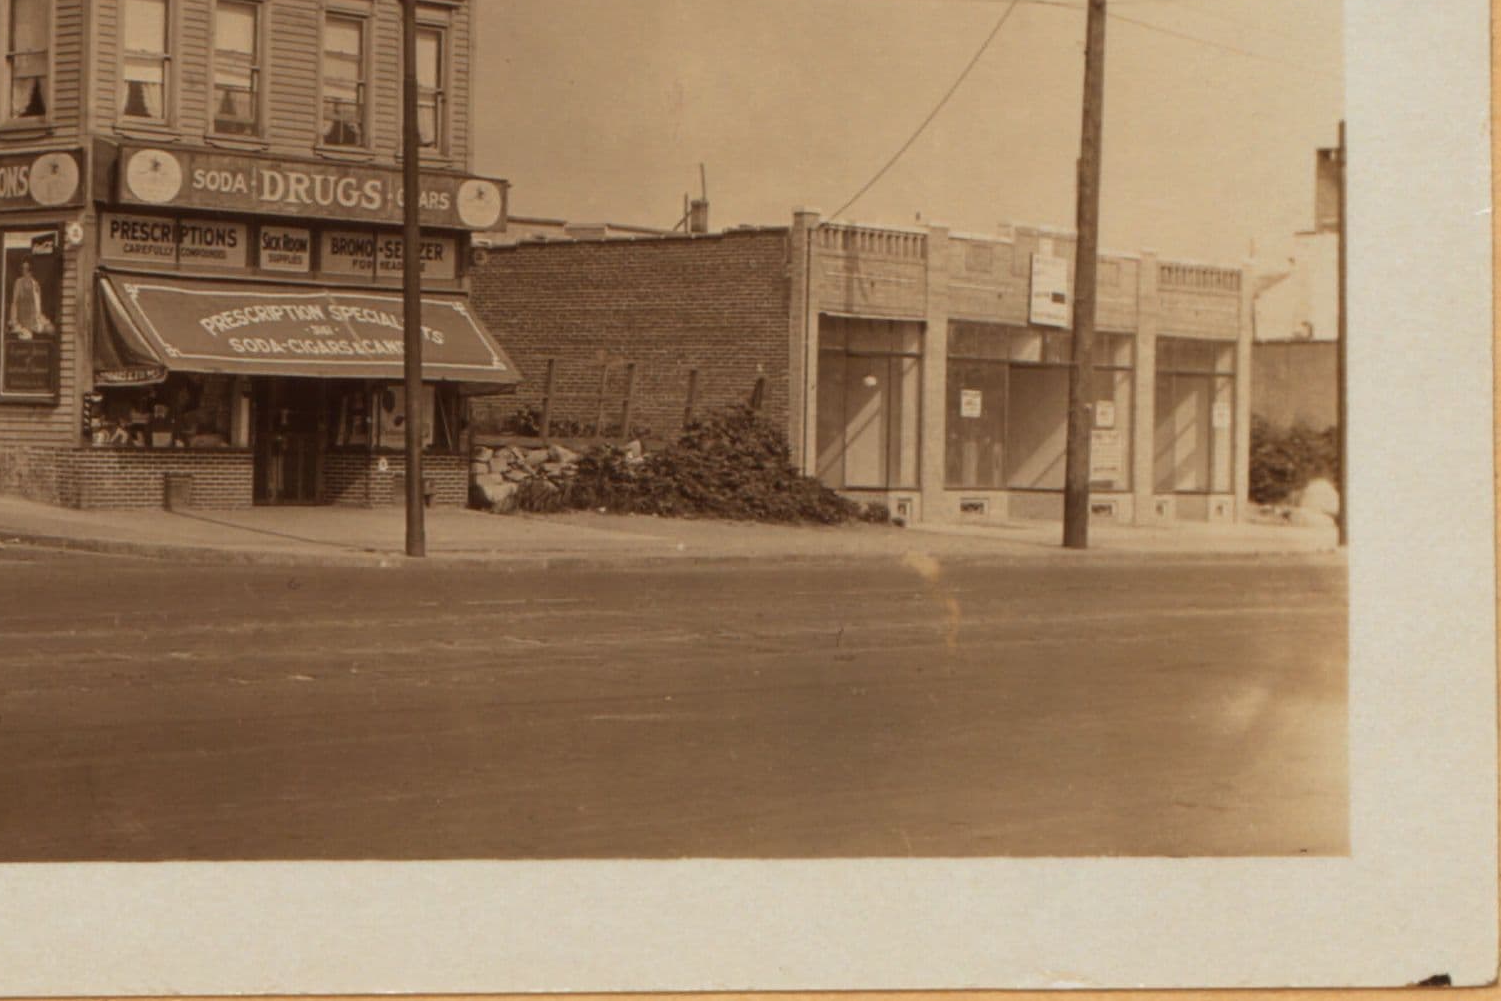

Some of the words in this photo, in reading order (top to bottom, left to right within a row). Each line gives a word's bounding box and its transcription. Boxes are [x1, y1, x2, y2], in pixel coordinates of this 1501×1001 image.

[192, 169, 248, 193] SODA
[260, 169, 382, 210] DRUGS
[396, 188, 450, 210] CARS
[110, 219, 237, 248] PRESCRIPTIONS
[331, 236, 443, 261] BROMO-SEZER
[200, 305, 325, 337] PRESCRIPTION
[327, 305, 444, 345] SPECIALTS
